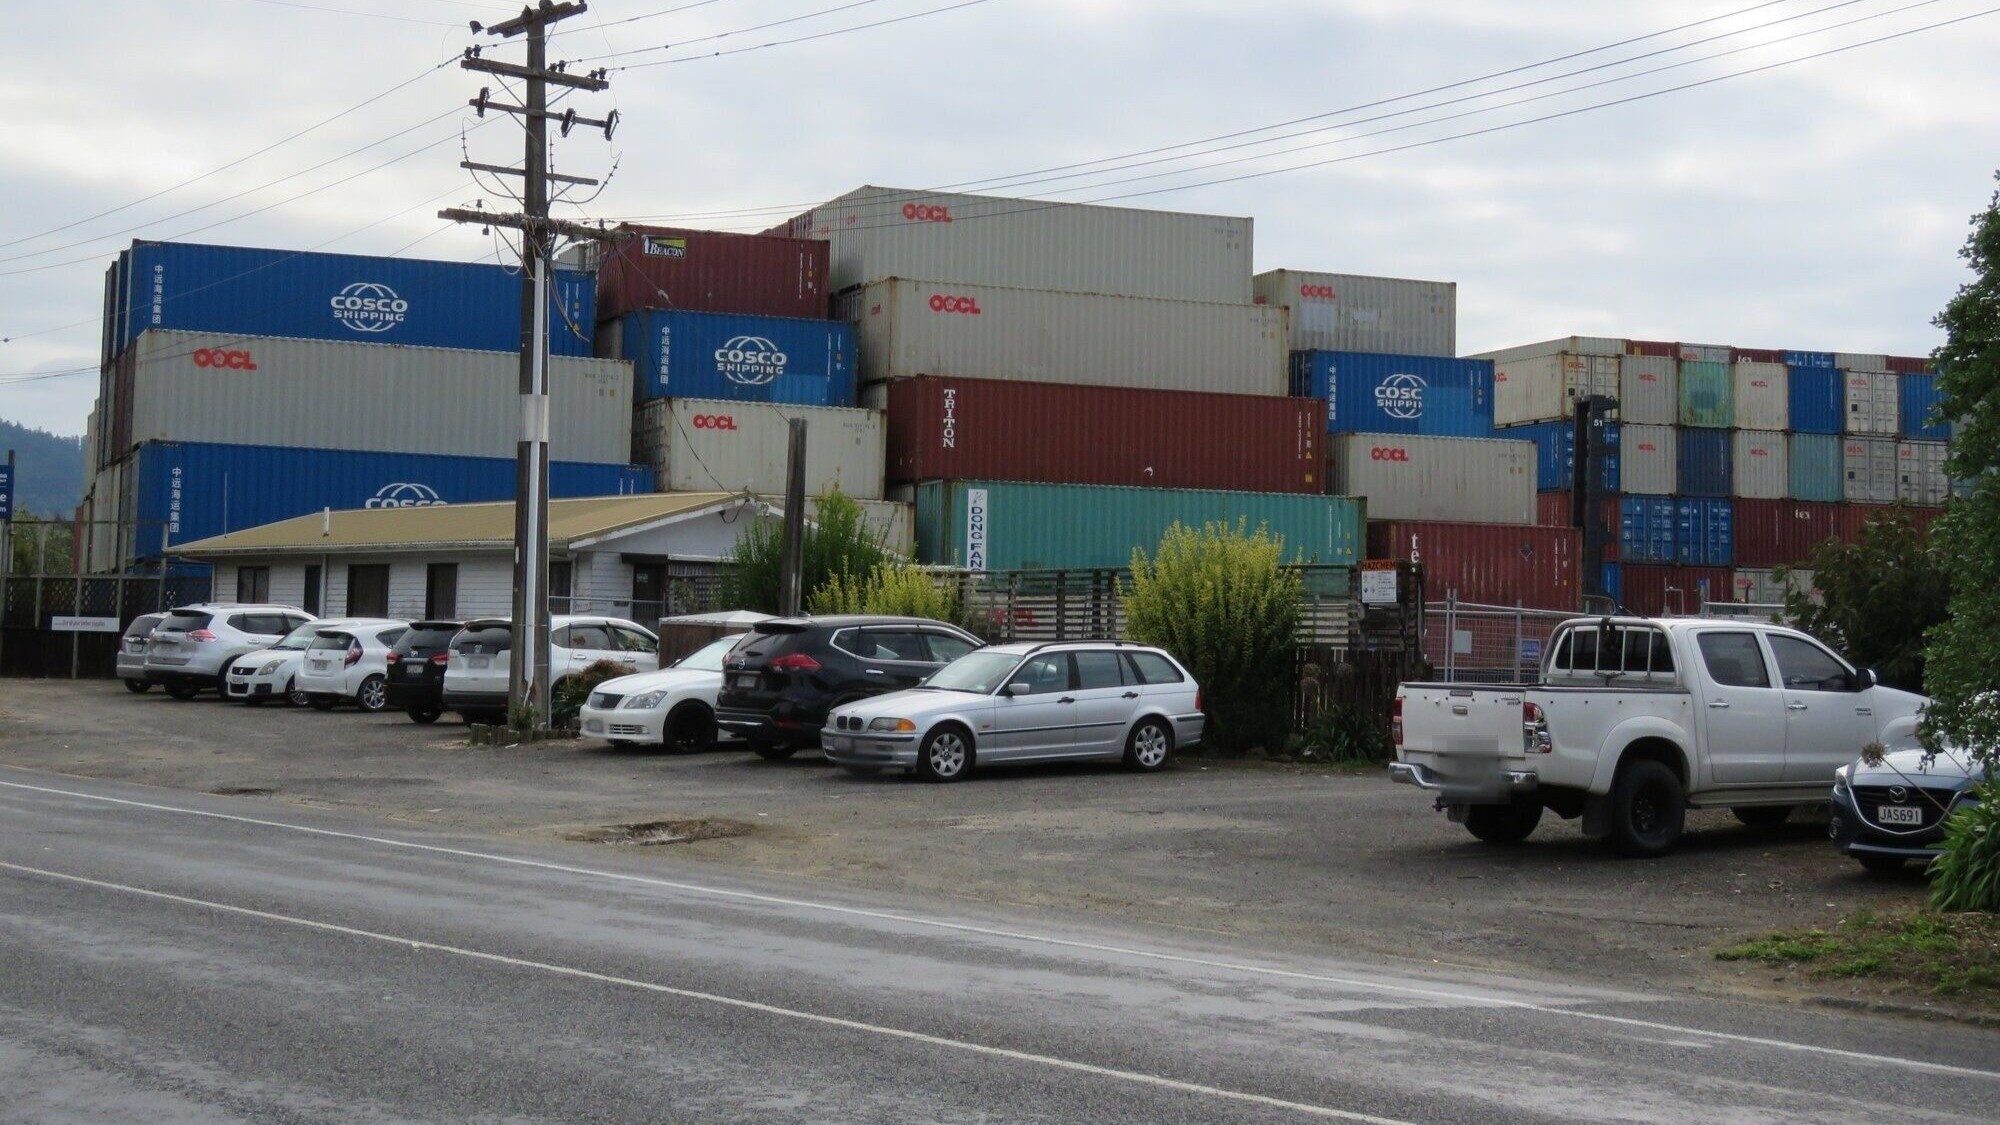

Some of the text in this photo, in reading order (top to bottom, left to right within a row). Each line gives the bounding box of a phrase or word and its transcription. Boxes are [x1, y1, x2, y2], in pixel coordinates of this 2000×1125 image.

[902, 203, 953, 222] OOCL
[650, 243, 685, 258] BEACON
[152, 264, 163, 325] 中远海运集团
[1300, 284, 1336, 298] OOCL
[330, 295, 408, 313] COSCO
[929, 294, 981, 315] OOCL
[333, 310, 405, 322] SHIPPING
[193, 348, 258, 370] OOCL
[660, 326, 671, 385] 中远海运集团
[714, 349, 787, 366] COSCO
[717, 362, 784, 375] SHIPPING
[693, 414, 738, 431] OOCL
[943, 389, 955, 448] TRITON
[1594, 419, 1603, 427] 51
[1371, 447, 1409, 462] OOCL
[169, 466, 182, 534] 中远海运集团
[970, 506, 983, 539] DONG
[1411, 533, 1420, 573] te
[1361, 561, 1396, 571] HAZCHEM
[1880, 808, 1919, 821] JAS691
